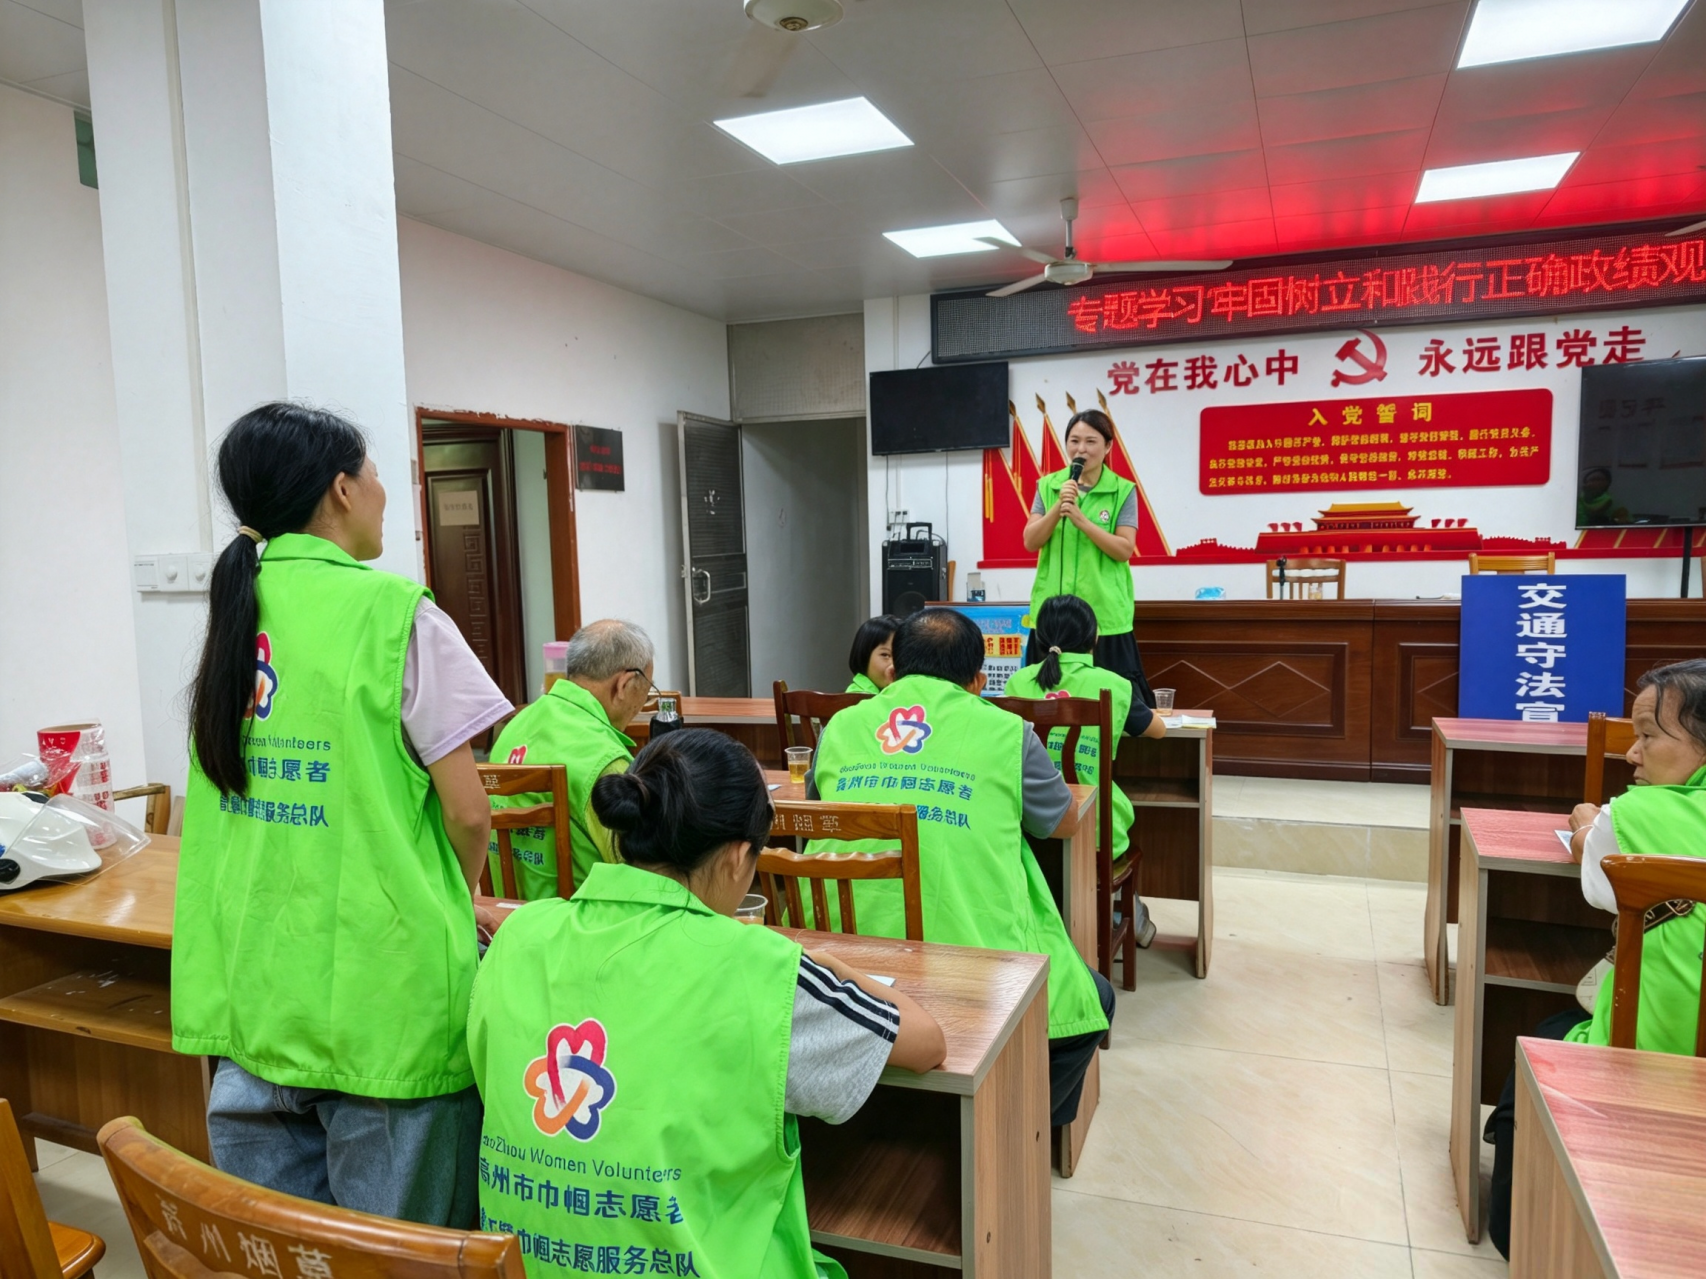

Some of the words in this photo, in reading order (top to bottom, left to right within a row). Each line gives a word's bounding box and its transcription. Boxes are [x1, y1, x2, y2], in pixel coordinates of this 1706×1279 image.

[1067, 239, 1706, 333] 专题学习牢固树立和践行正确政绩观
[1107, 349, 1299, 397] 党在我心中
[1417, 326, 1646, 377] 永远跟党走
[1308, 402, 1433, 426] 入党誓词
[530, 1147, 587, 1174] Women
